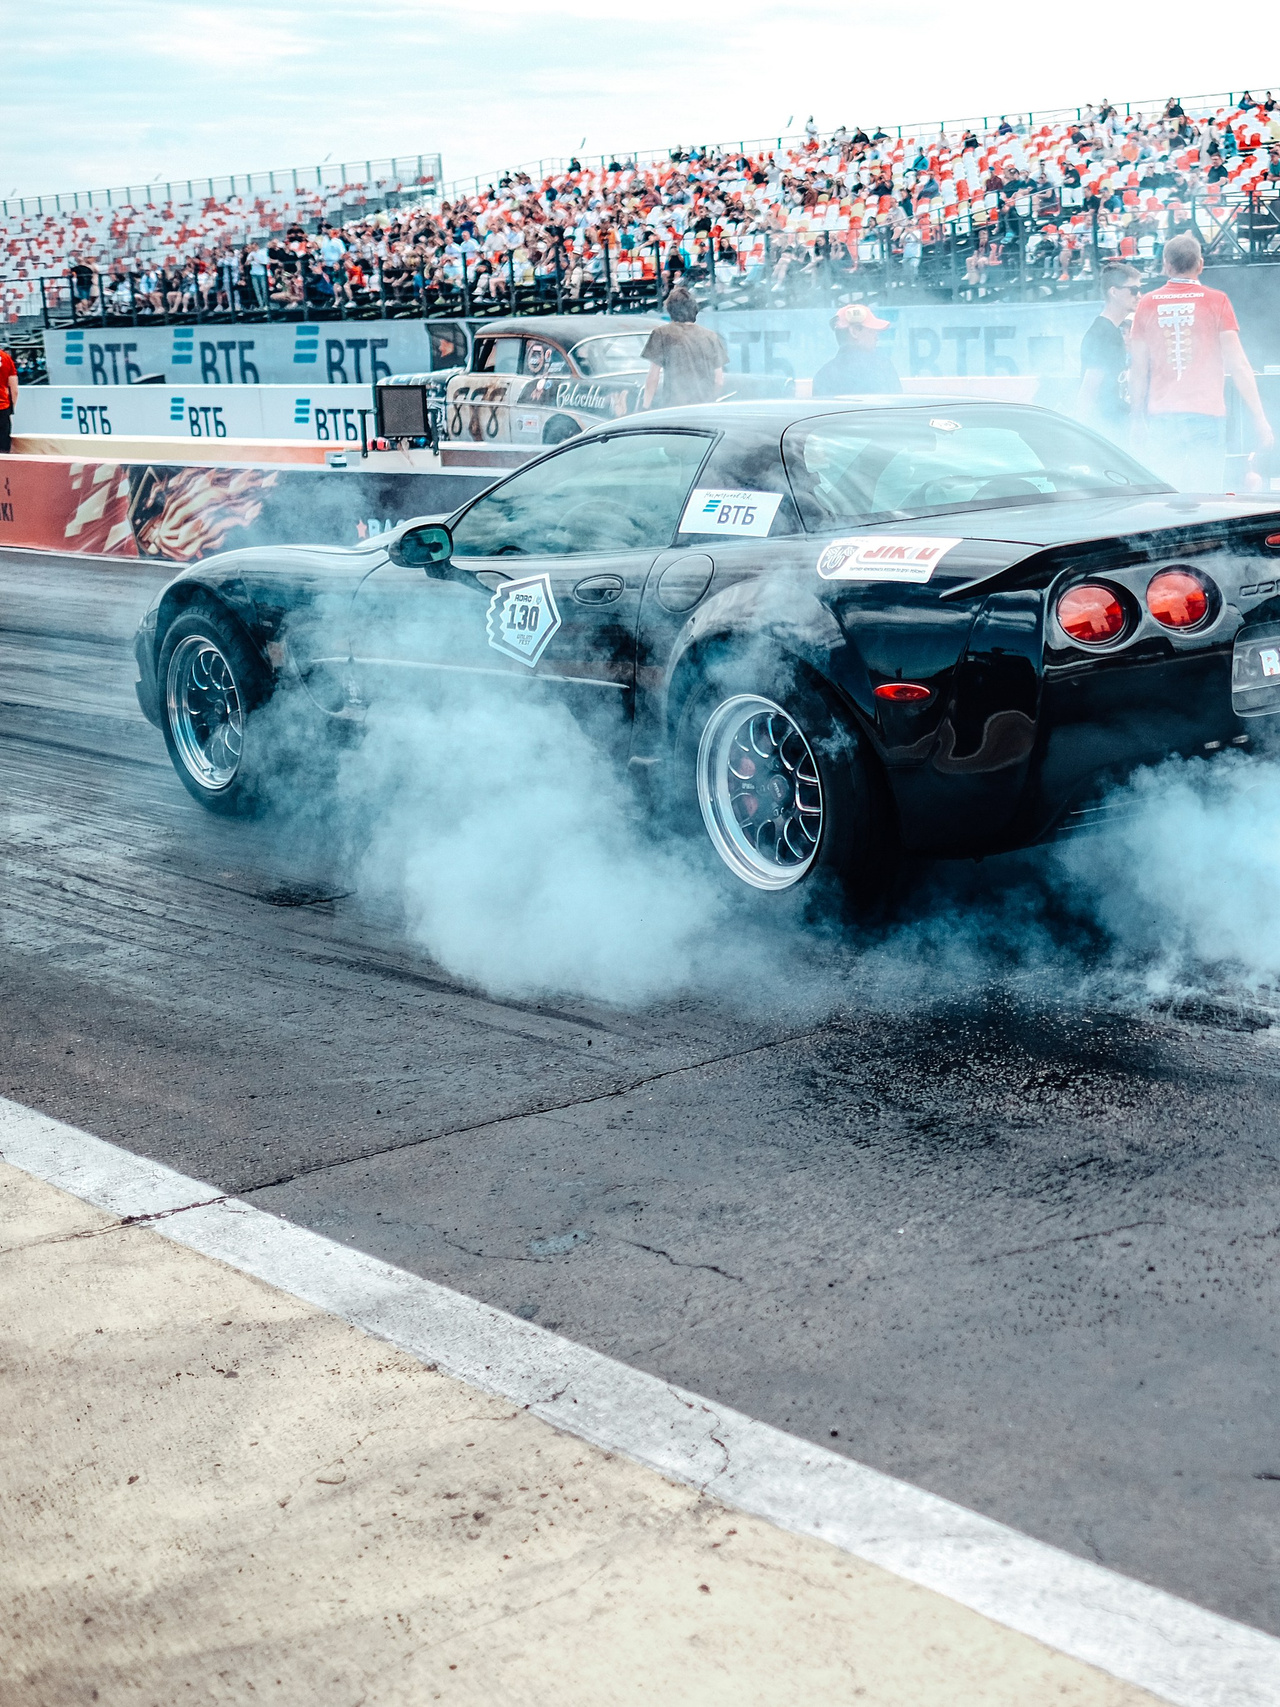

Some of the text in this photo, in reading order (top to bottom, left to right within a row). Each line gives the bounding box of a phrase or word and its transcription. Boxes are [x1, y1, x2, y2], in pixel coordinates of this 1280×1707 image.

[88, 343, 142, 385] ВТБ
[199, 341, 260, 384] ВТБ
[325, 338, 393, 384] ВТБ
[729, 330, 796, 376] ТБ
[77, 406, 112, 434] ВТБ
[188, 407, 227, 437] ВТБ
[315, 409, 358, 440] ВТБ
[717, 505, 758, 525] ВТБ
[506, 603, 540, 632] 130
